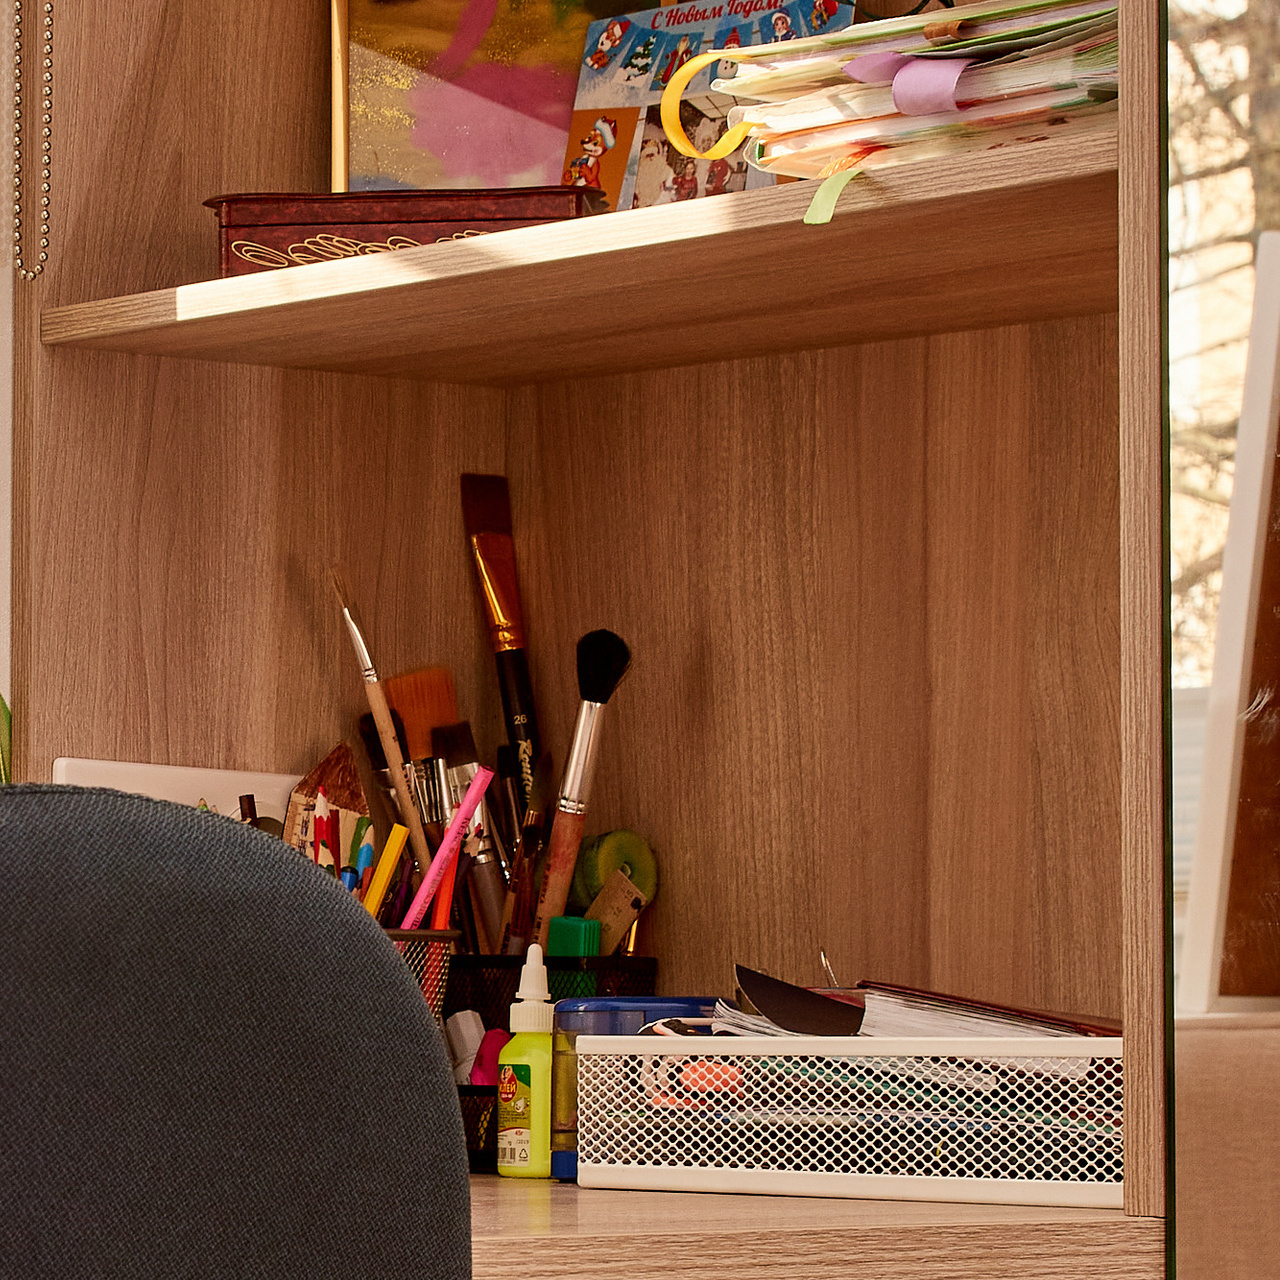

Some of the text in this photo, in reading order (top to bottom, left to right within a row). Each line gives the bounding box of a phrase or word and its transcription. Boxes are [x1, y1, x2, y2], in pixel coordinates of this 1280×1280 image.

[650, 11, 664, 30] С
[665, 4, 724, 28] Новым
[513, 714, 528, 725] 26
